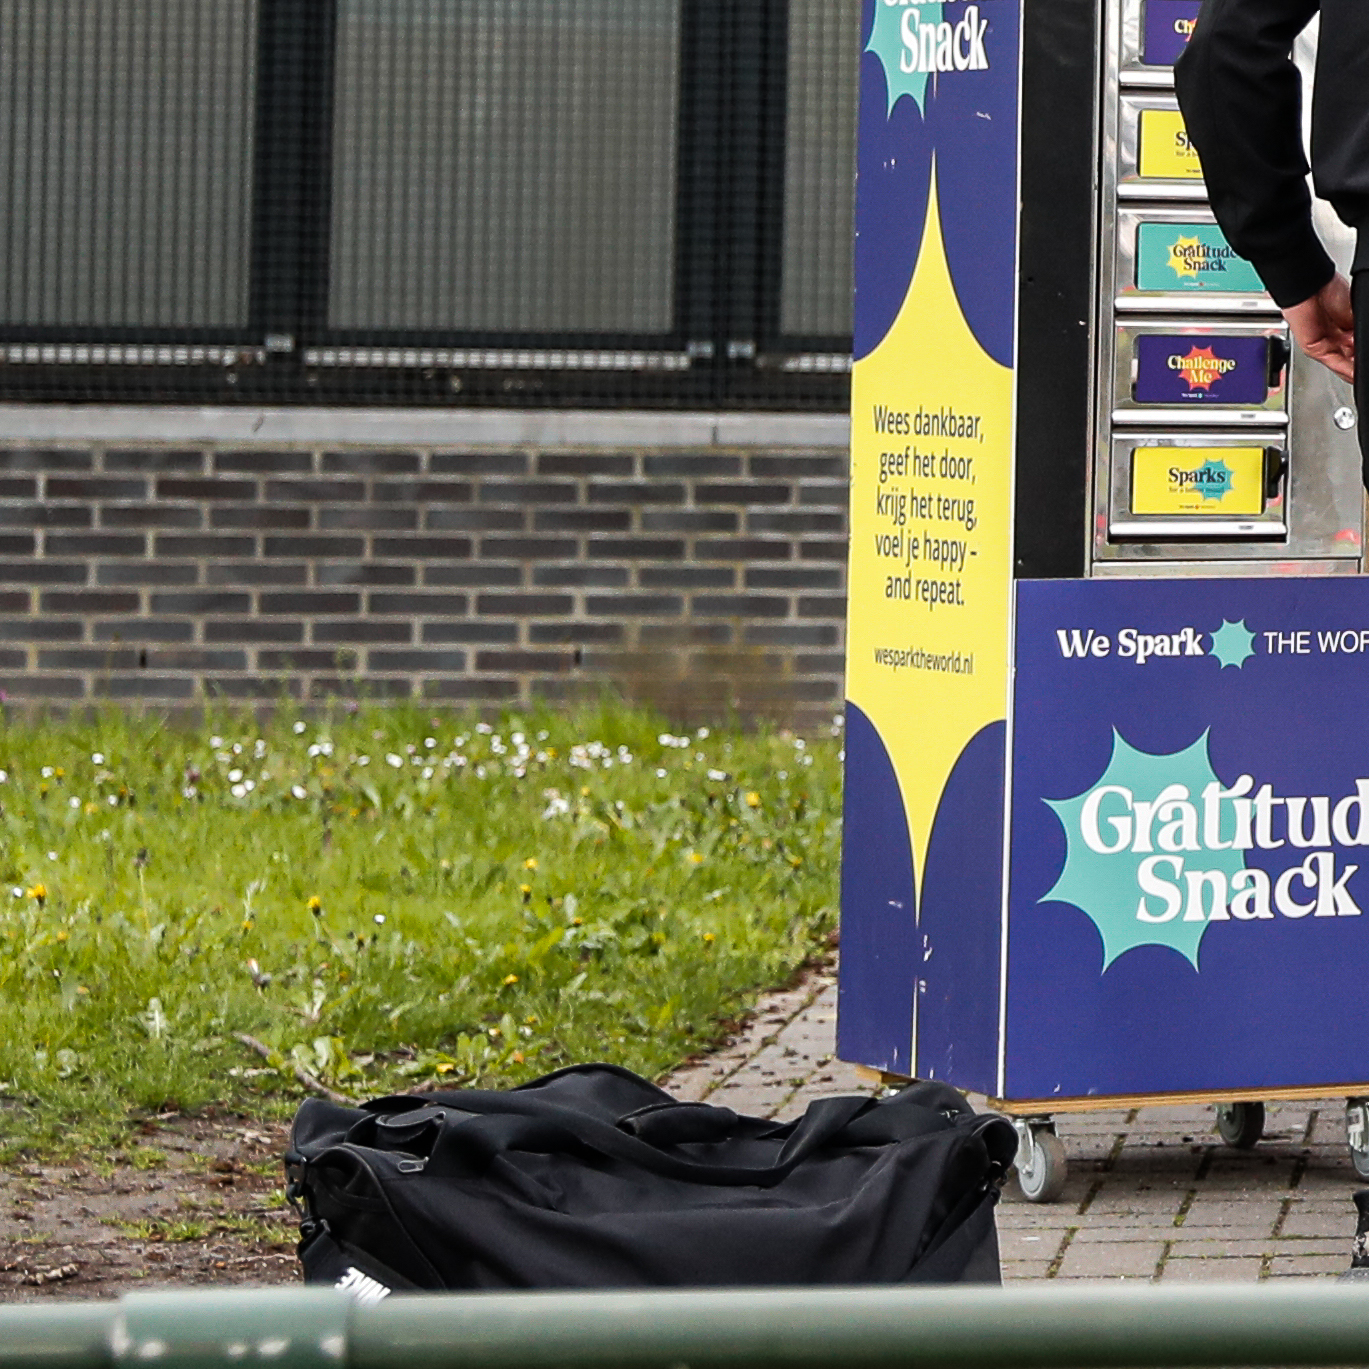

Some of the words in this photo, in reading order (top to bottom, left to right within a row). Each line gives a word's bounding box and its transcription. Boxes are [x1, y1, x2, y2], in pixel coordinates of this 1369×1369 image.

[899, 6, 989, 74] Snack
[1183, 258, 1227, 272] Snack
[1167, 354, 1236, 374] Challenge
[1190, 370, 1212, 383] Me
[873, 404, 910, 435] Wees
[914, 404, 984, 444] dankbaar,
[879, 445, 910, 483] geef
[913, 446, 936, 478] het
[939, 447, 976, 485] door,
[1168, 467, 1226, 486] Sparks
[876, 485, 906, 526] krijg
[910, 487, 933, 520] het
[937, 493, 978, 531] terug,
[875, 528, 904, 558] voel
[906, 529, 919, 568] je
[923, 529, 967, 572] happy
[885, 569, 911, 600] and
[915, 578, 965, 612] repeat.
[874, 646, 974, 675] wesparktheworld.nl
[1056, 629, 1110, 658] We
[1117, 627, 1205, 665] Spark
[1263, 631, 1310, 654] THE
[1135, 850, 1362, 924] Snack
